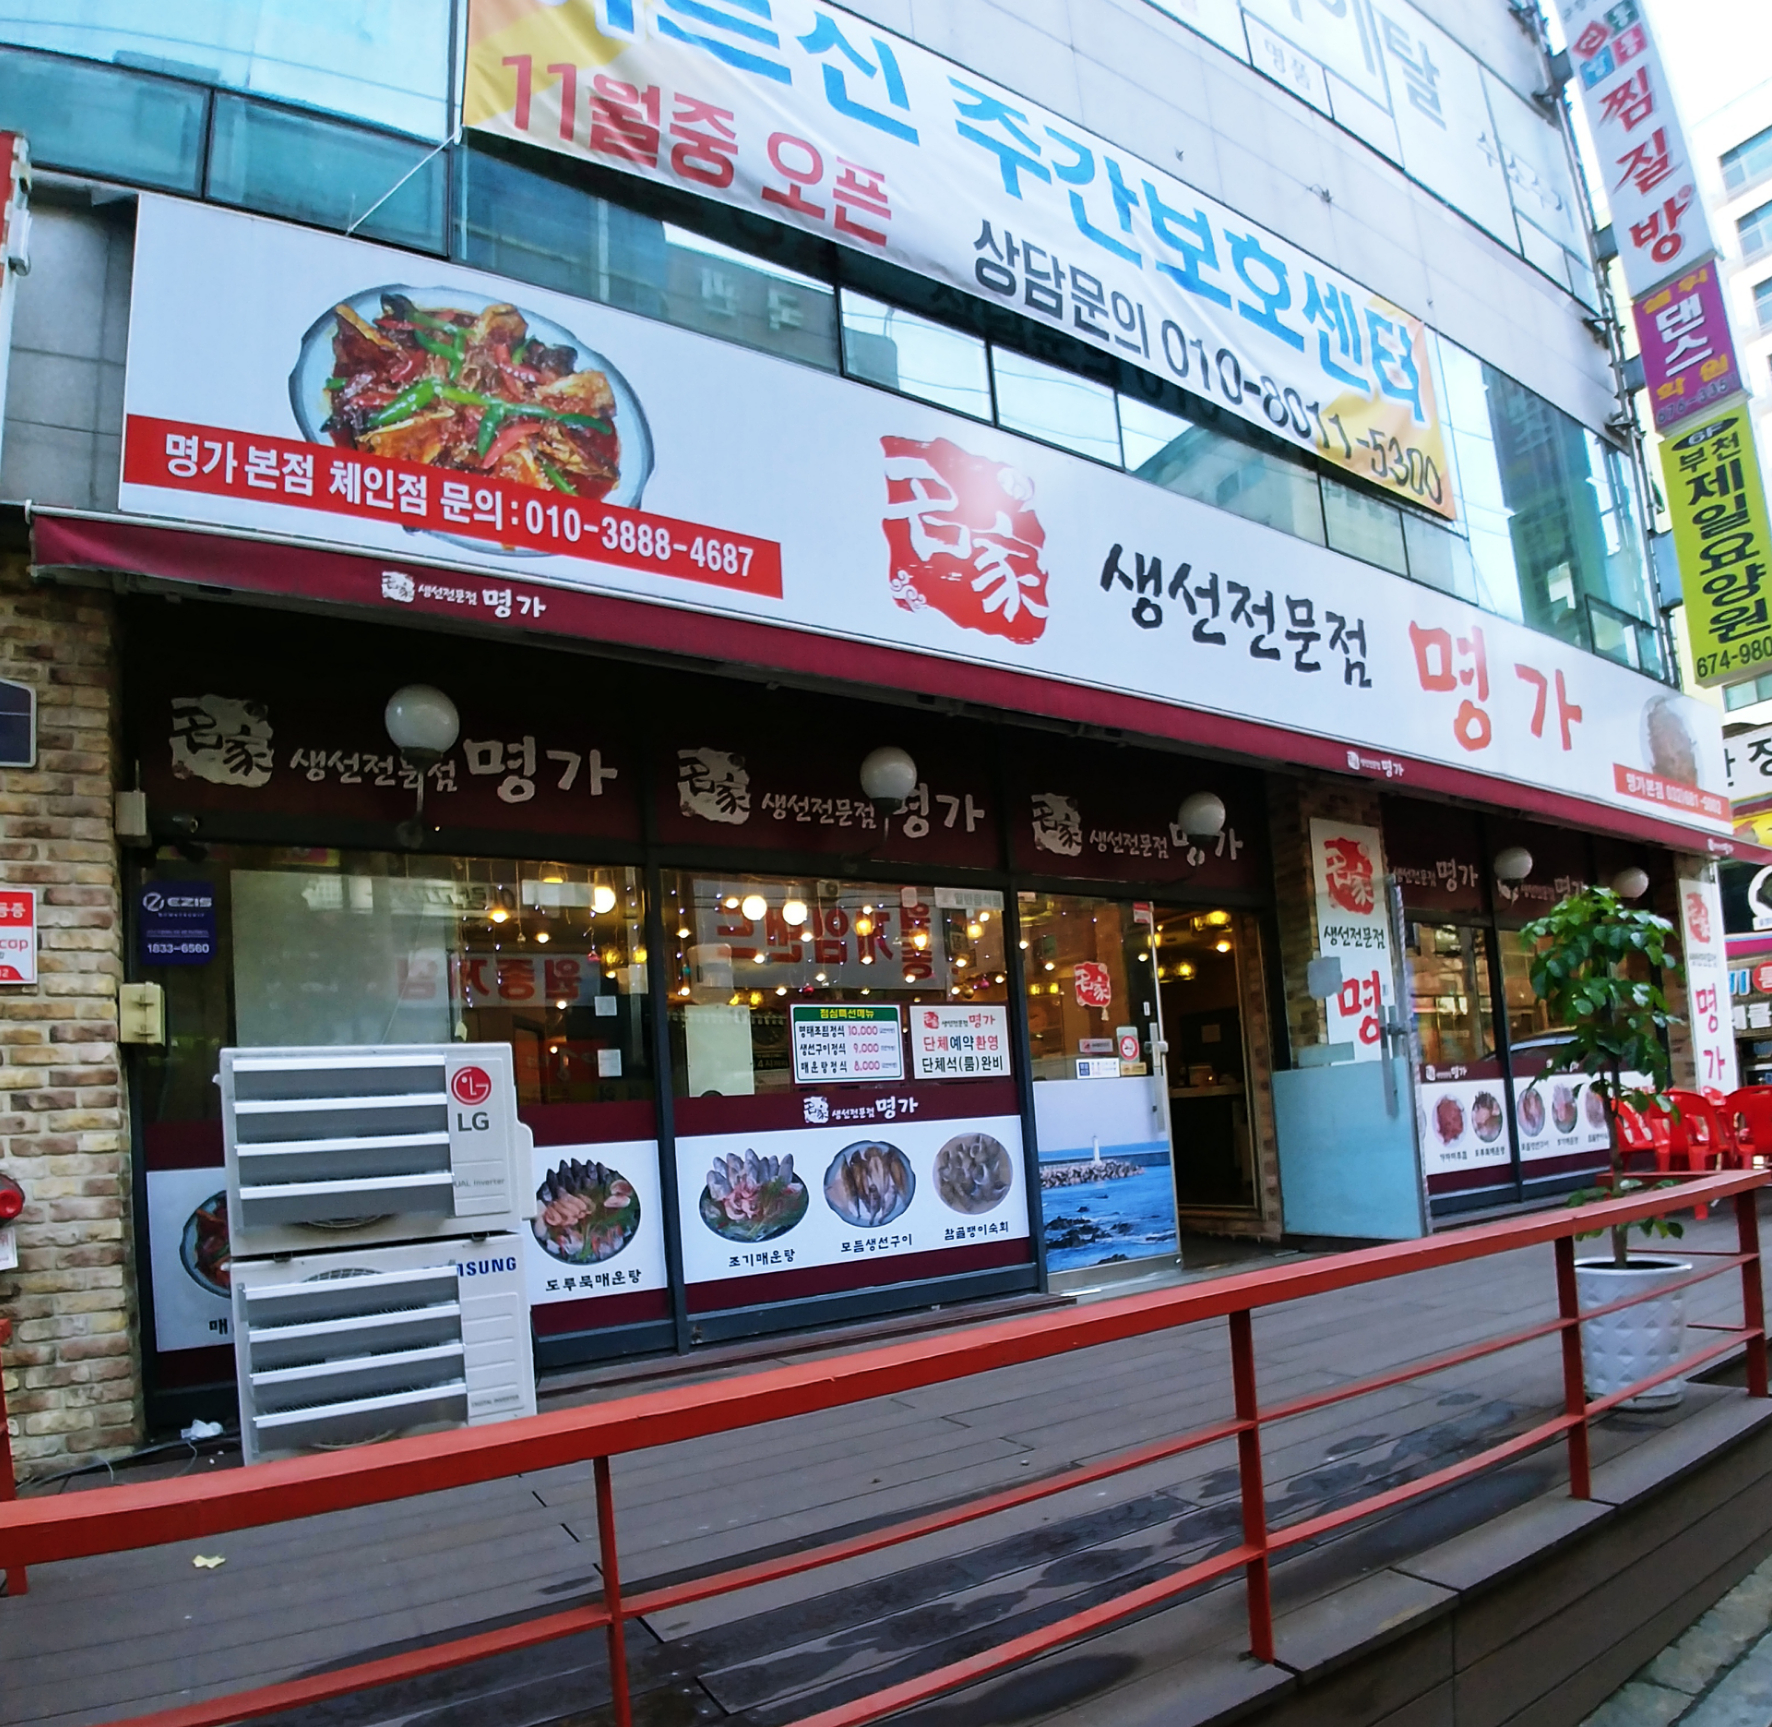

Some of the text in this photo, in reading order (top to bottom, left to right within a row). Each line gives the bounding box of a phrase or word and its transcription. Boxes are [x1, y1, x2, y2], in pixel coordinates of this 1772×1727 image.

[501, 54, 893, 248] 11월중 오픈
[1598, 65, 1690, 264] 찜질방
[605, 0, 1426, 424] 르신 주간보호센터
[1655, 292, 1714, 378] 댄스
[973, 218, 1444, 507] 상담문의 010-8011-5300
[1688, 421, 1724, 446] 6F
[1678, 431, 1742, 474] 부천
[164, 432, 238, 484] 명가
[245, 444, 316, 497] 본점
[328, 458, 429, 517] 체인점
[1684, 458, 1771, 644] 제일요양원
[418, 583, 547, 620] 생선전문점 명가
[1099, 543, 1584, 753] 생선전문점 명가
[462, 735, 618, 804] 명가
[761, 791, 877, 831] 생선전문점
[1088, 829, 1170, 860] 생선전문점
[1436, 858, 1479, 893] 명가
[1323, 923, 1387, 951] 생선전문점
[798, 1024, 845, 1038] 명태조림정식
[820, 1008, 875, 1019] 점심특선메뉴
[968, 1013, 996, 1029] 명가
[1695, 982, 1727, 1081] 명가
[799, 1043, 847, 1056] 생선구이정식
[457, 1111, 490, 1132] LG
[875, 1095, 919, 1120] 명가
[840, 1233, 913, 1253] 모듬생선구이
[944, 1221, 1009, 1241] 참골뱅이숙회
[728, 1248, 796, 1268] 조기매운탕
[545, 1268, 642, 1292] 도루묵매운탕
